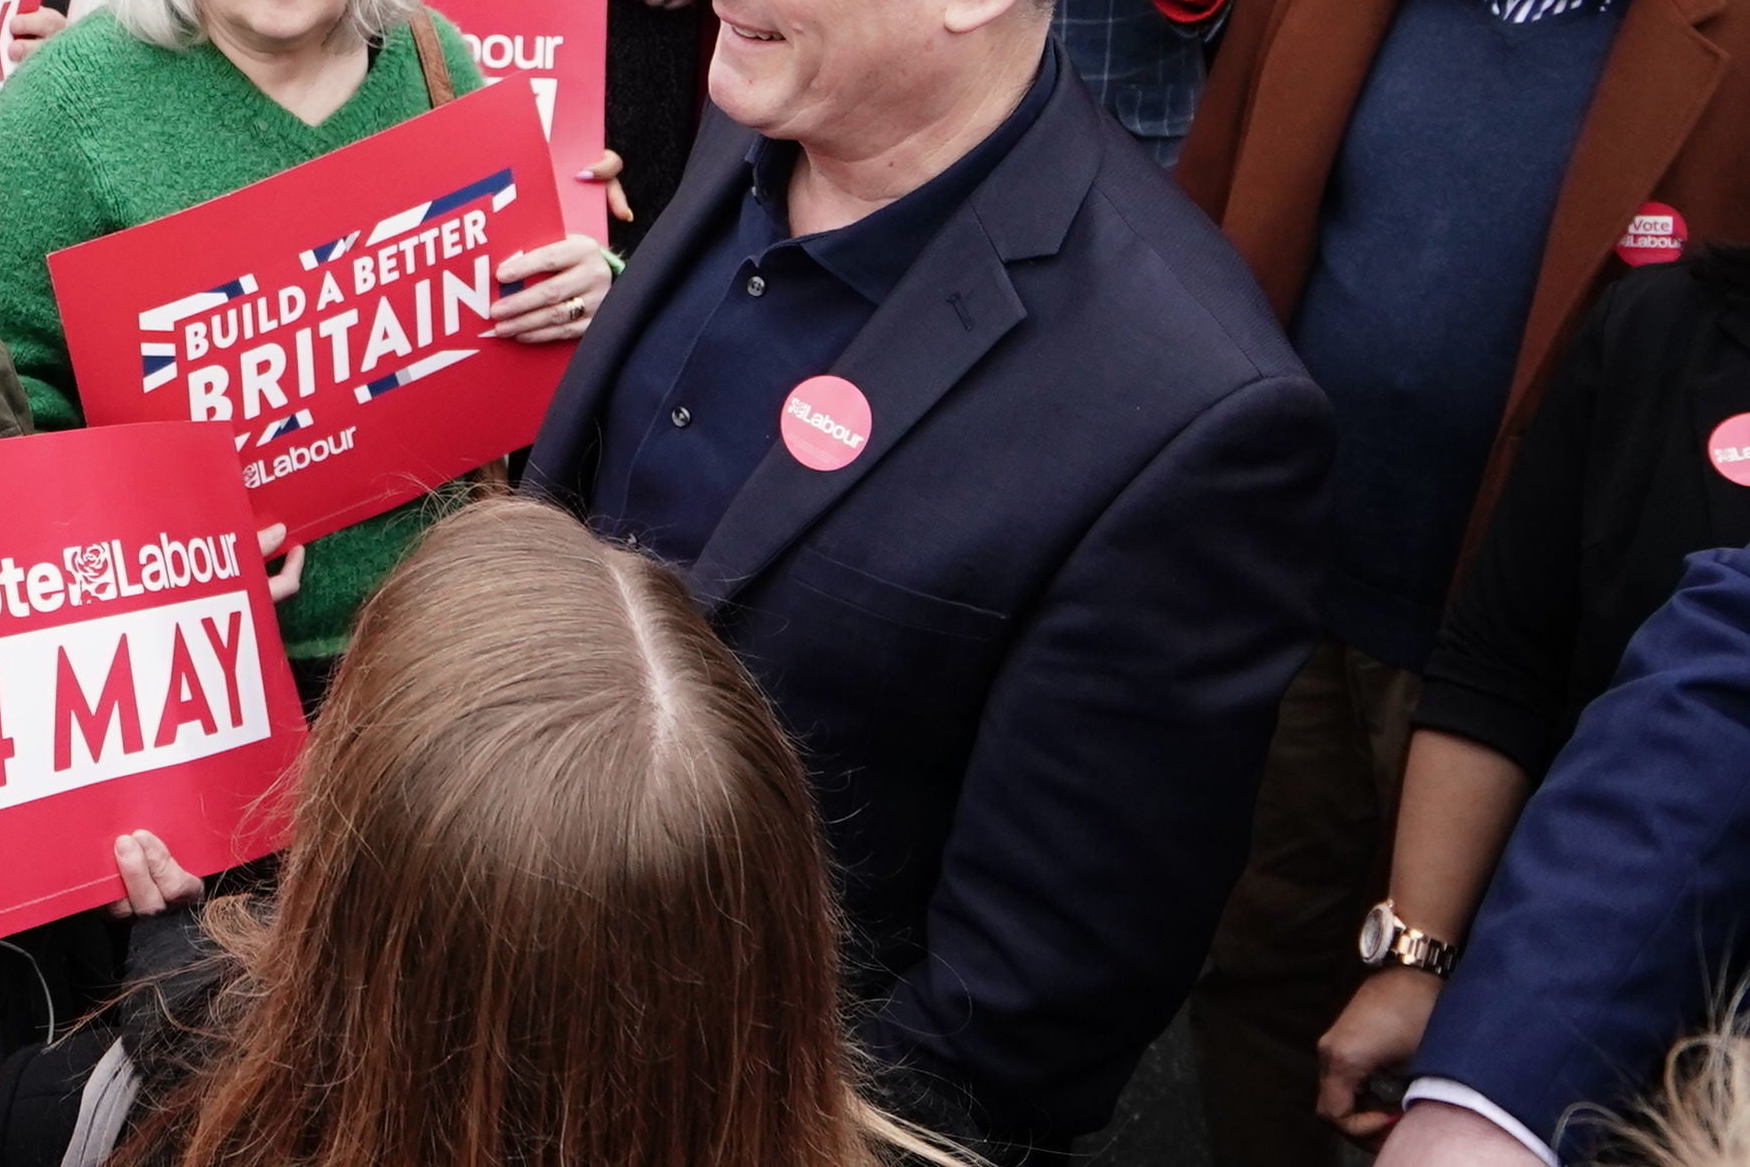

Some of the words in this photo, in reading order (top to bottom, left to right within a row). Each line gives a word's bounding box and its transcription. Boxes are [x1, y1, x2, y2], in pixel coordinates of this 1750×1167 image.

[1632, 219, 1670, 233] Vote
[184, 284, 307, 362] BUILD
[316, 270, 345, 312] A
[353, 209, 488, 296] BETTER
[187, 254, 492, 421] BRITAIN
[259, 426, 357, 484] Labour
[803, 405, 864, 449] Labour
[117, 532, 242, 598] Labour
[53, 611, 244, 773] MAY
